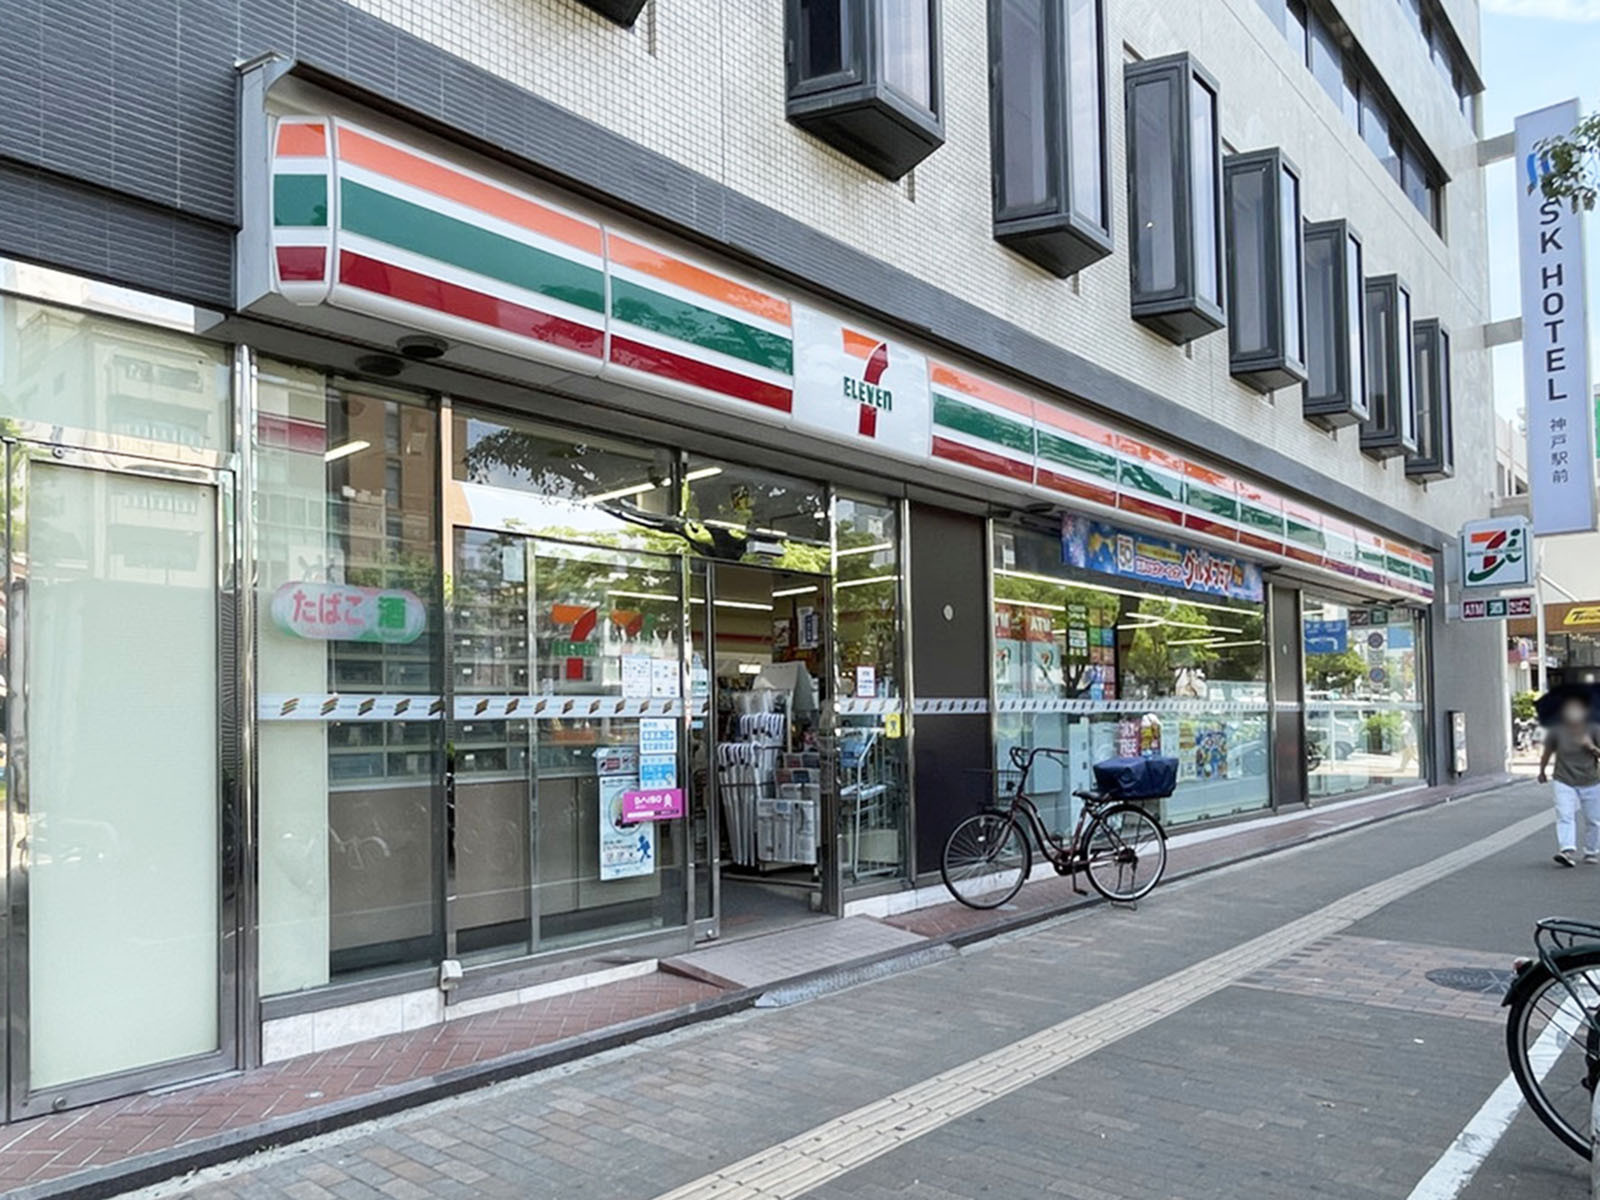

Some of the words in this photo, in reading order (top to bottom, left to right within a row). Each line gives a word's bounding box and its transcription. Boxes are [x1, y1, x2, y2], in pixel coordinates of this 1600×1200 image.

[1542, 264, 1568, 402] HOTEL
[1550, 418, 1569, 484] 神戸駅前
[293, 590, 366, 625] たばこ
